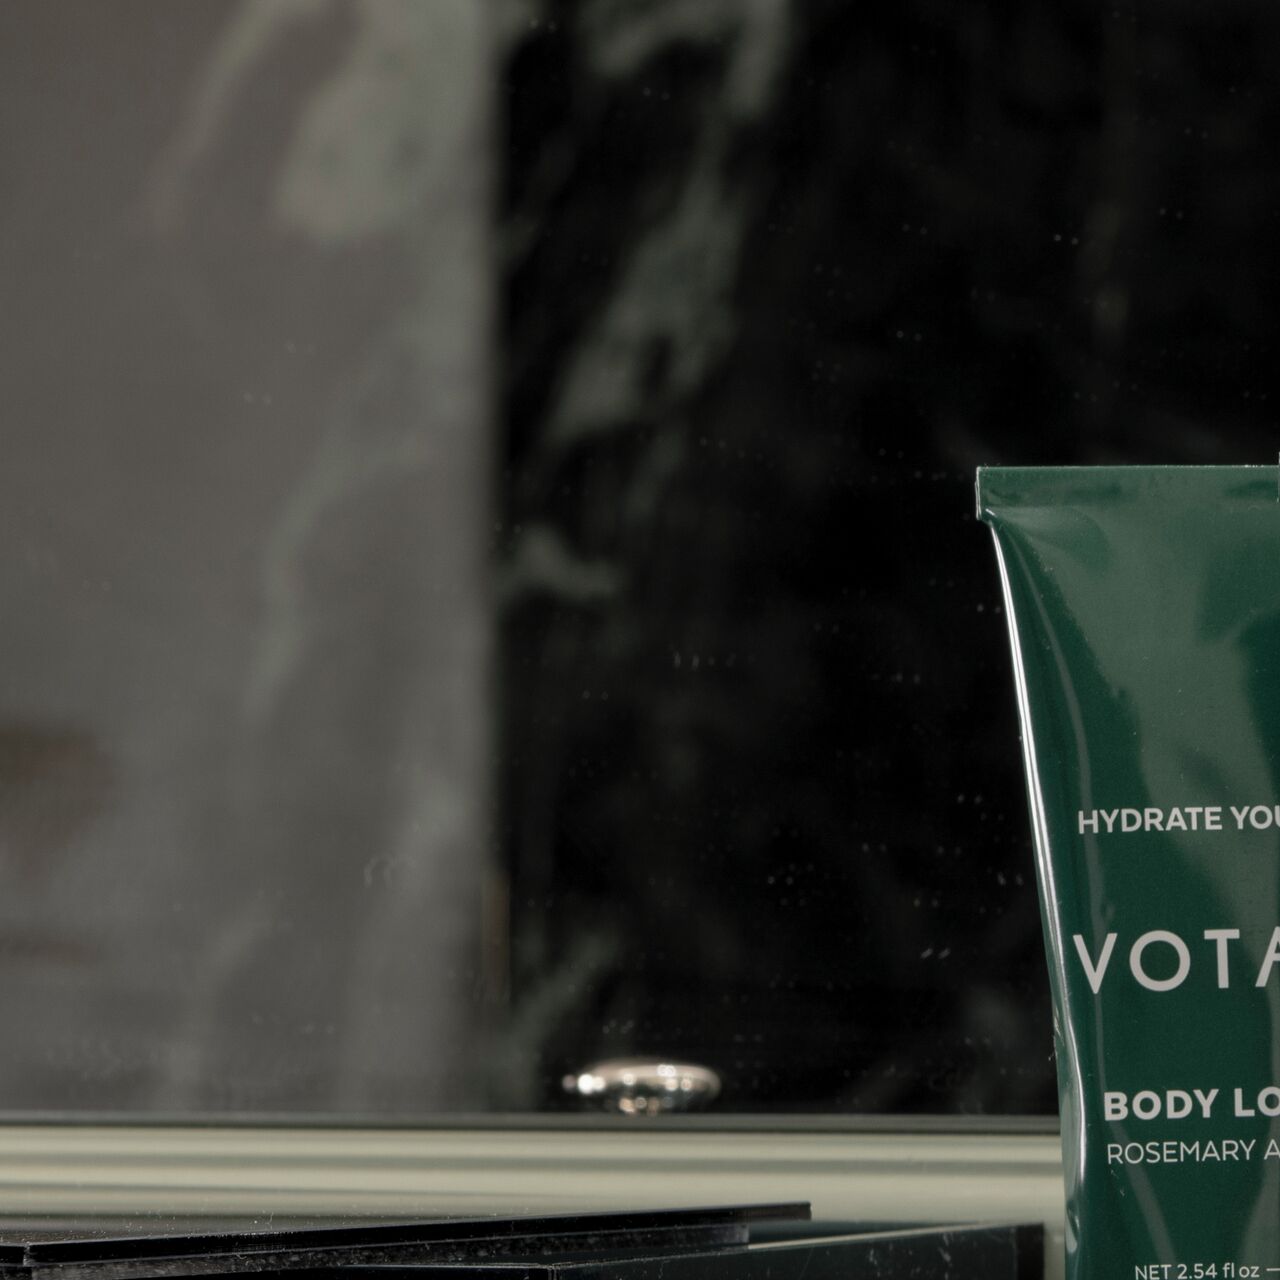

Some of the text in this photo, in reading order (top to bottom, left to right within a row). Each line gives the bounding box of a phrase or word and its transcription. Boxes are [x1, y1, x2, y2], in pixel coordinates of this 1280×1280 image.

[1078, 806, 1222, 834] HYDRATE
[1104, 1088, 1219, 1121] BODY
[1107, 1139, 1256, 1165] ROSEMARY
[1135, 1264, 1172, 1280] NET
[1177, 1263, 1217, 1280] 2.54
[1223, 1263, 1235, 1279] fl
[1239, 1266, 1260, 1278] oz
